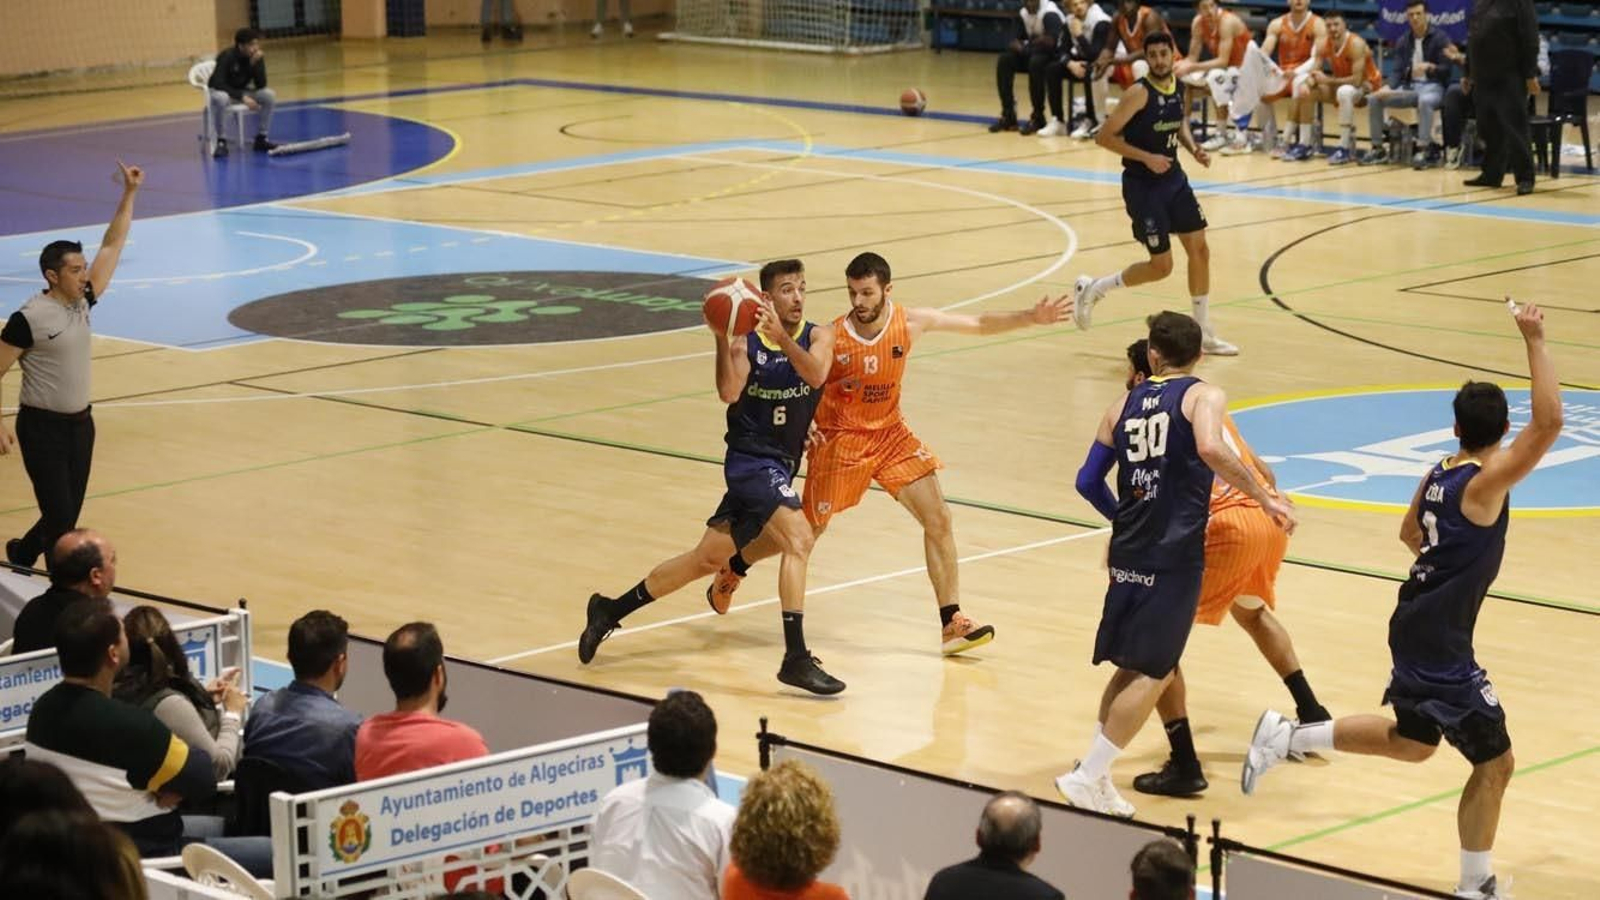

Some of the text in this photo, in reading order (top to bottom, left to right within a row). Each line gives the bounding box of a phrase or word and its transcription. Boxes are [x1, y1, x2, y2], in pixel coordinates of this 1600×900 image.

[864, 354, 879, 375] 13
[747, 382, 810, 400] damex.io
[773, 405, 787, 426] 6
[1124, 411, 1170, 462] 30
[380, 753, 605, 817] Ayuntamiento de Algeciras
[391, 789, 598, 846] Delegación de Deportes
